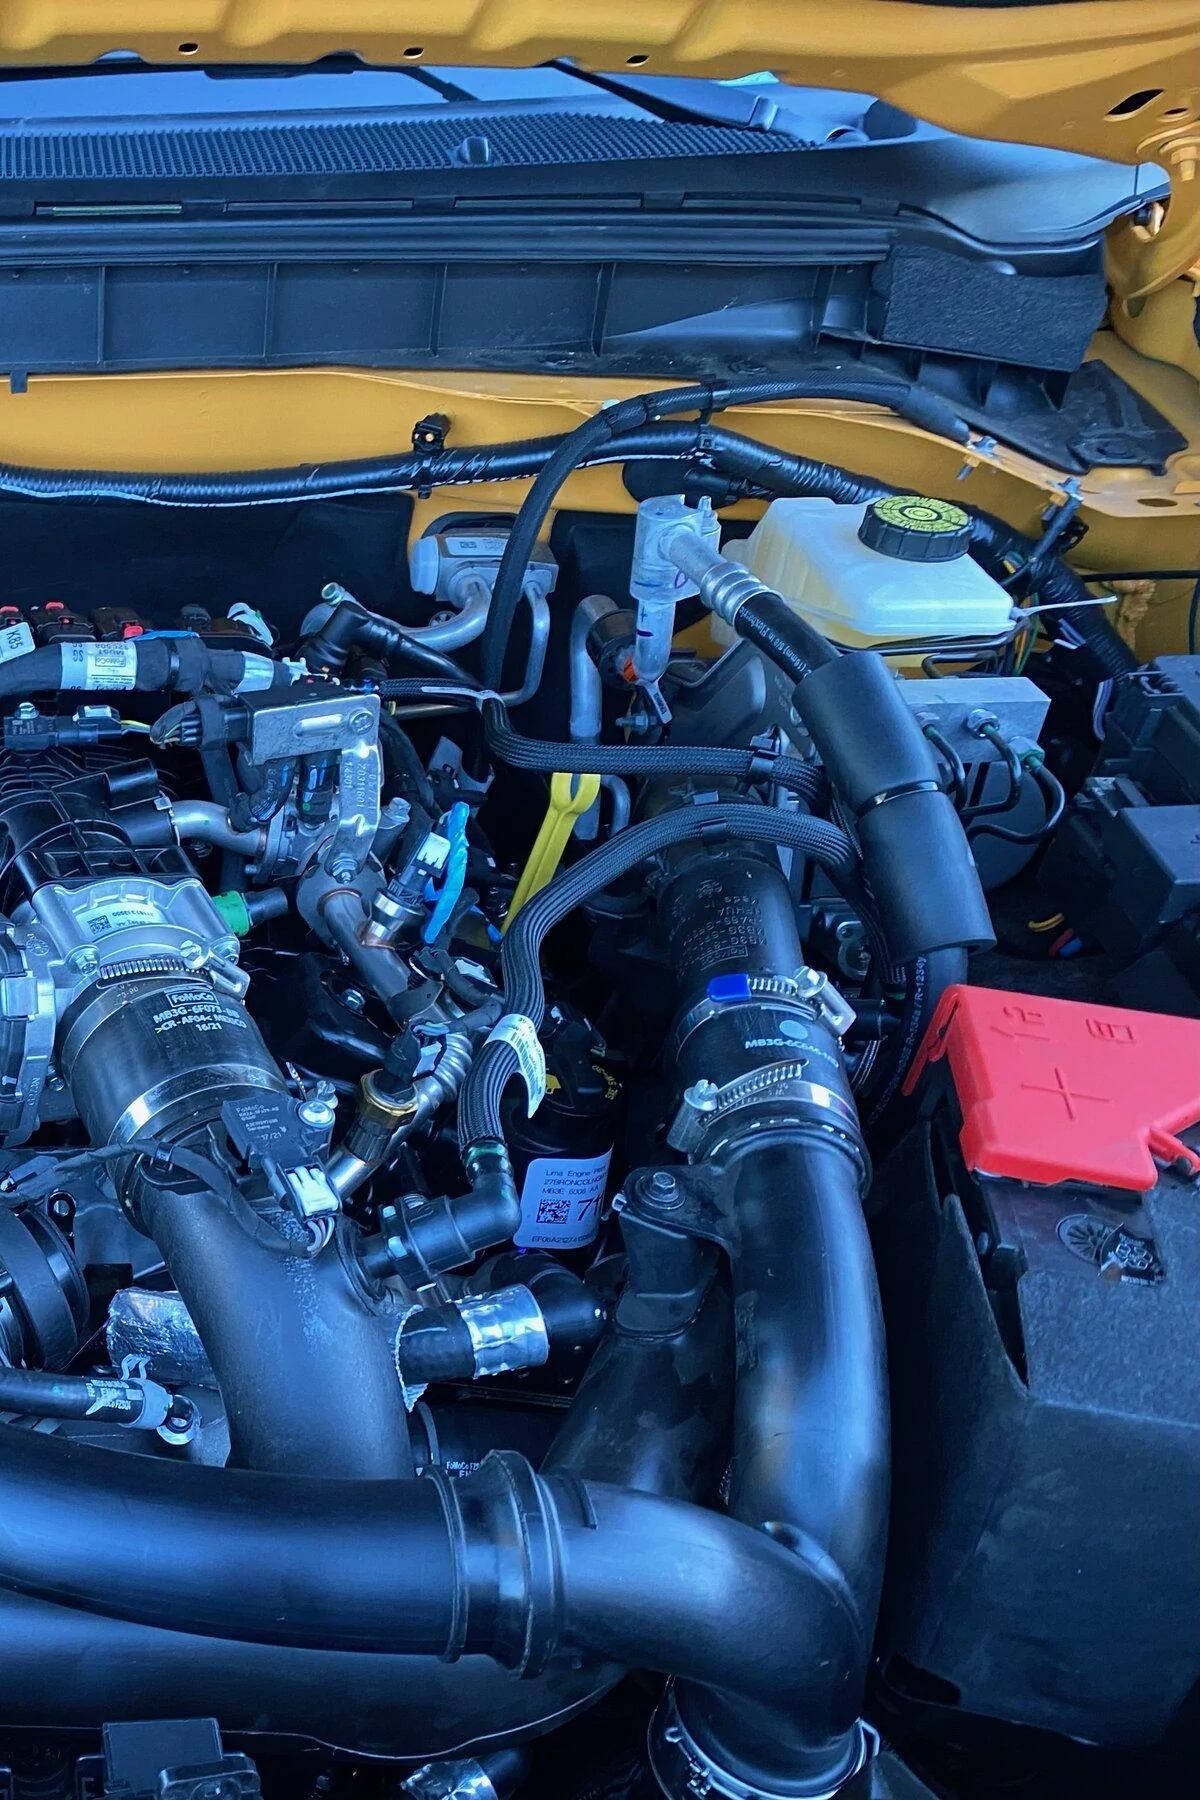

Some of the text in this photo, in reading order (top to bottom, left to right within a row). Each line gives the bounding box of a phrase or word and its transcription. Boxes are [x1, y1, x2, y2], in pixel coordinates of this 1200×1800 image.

[6, 630, 23, 650] K85
[72, 650, 83, 662] SG
[171, 993, 214, 1003] FoMoCo
[196, 1023, 222, 1031] 16/21
